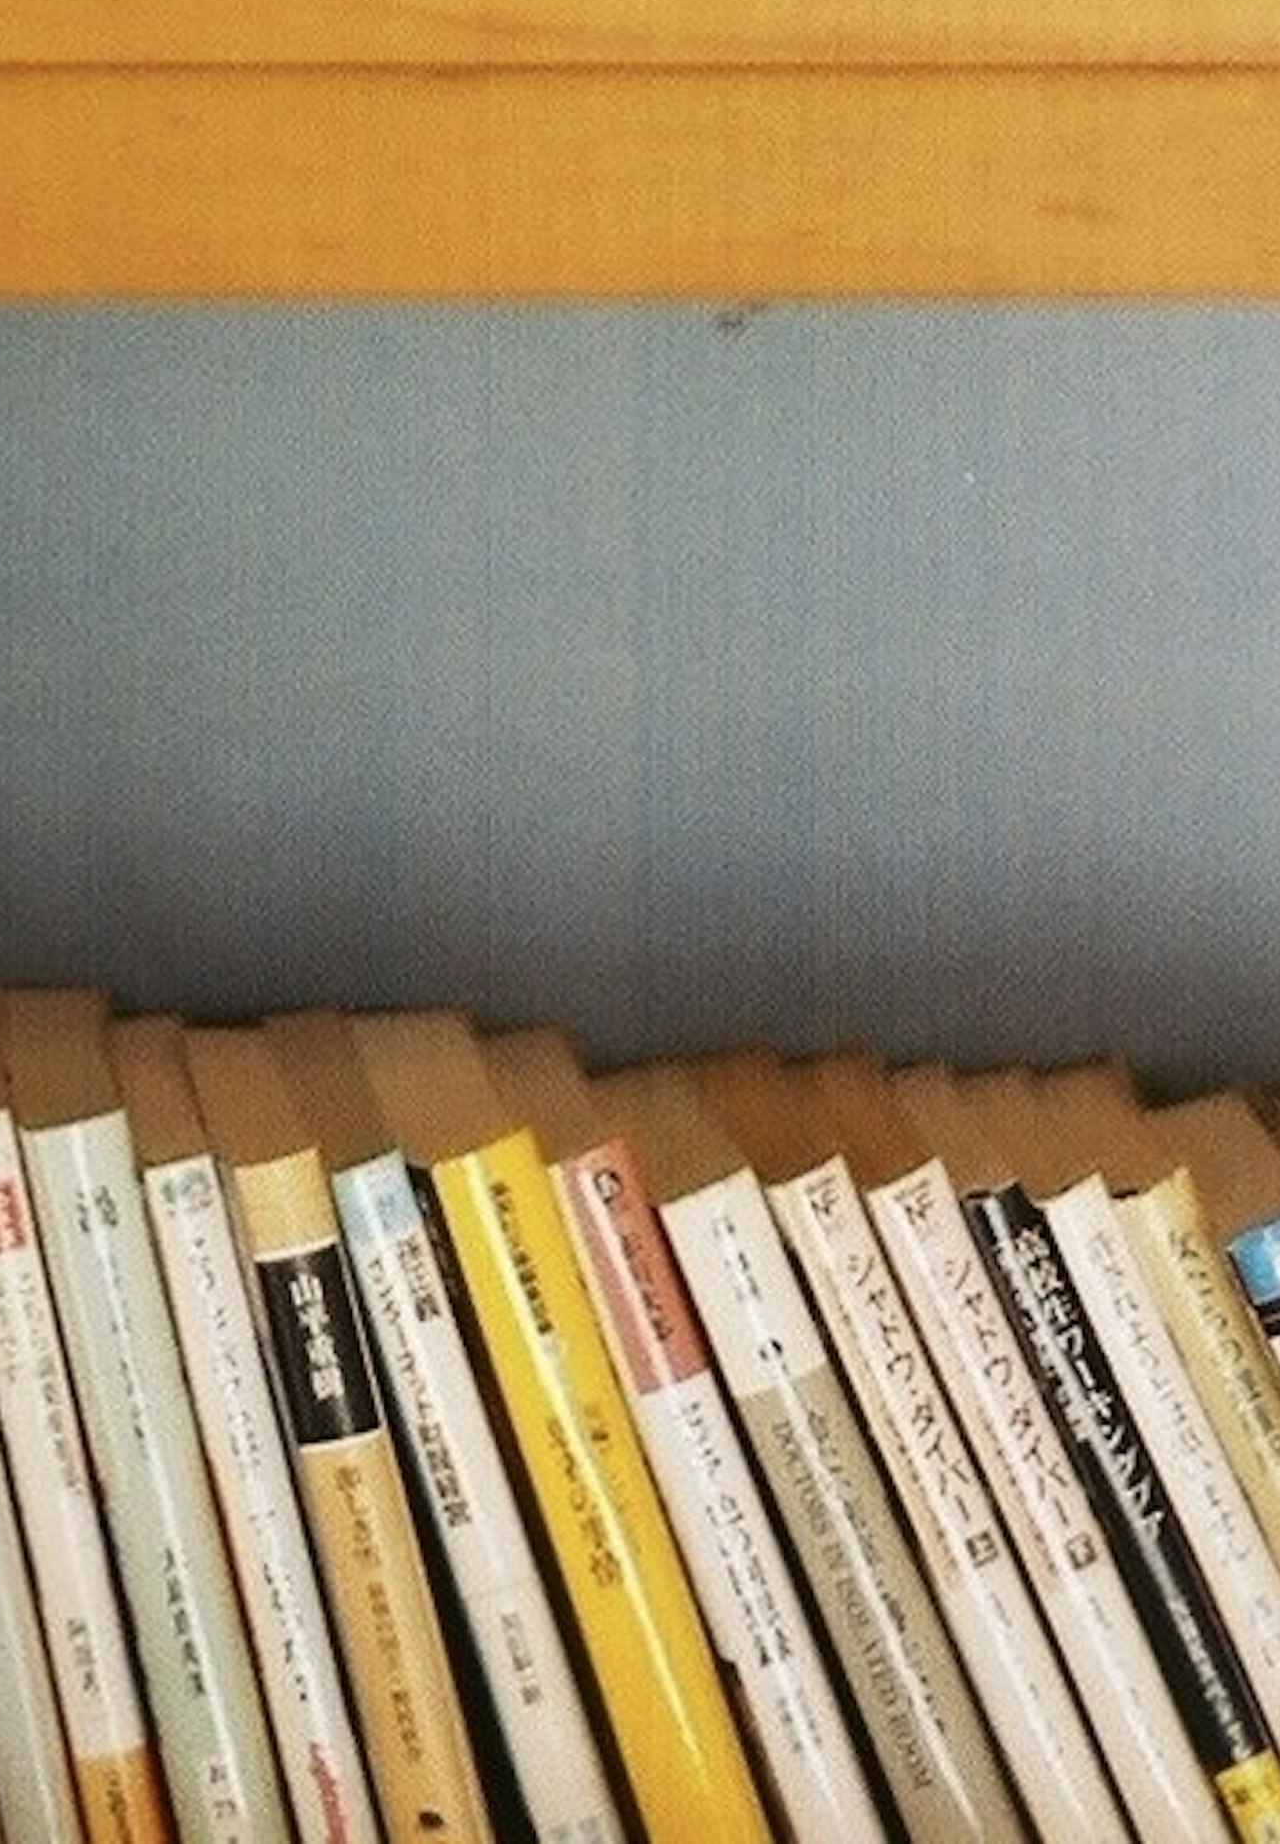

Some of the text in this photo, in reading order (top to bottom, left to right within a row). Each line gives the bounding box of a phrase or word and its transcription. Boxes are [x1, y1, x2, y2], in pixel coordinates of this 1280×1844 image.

[846, 1251, 972, 1526] シャドウ・ダイバー
[943, 1253, 1073, 1528] シャドウ・ダイバー
[1016, 1223, 1167, 1538] 高校生ワーキングプア
